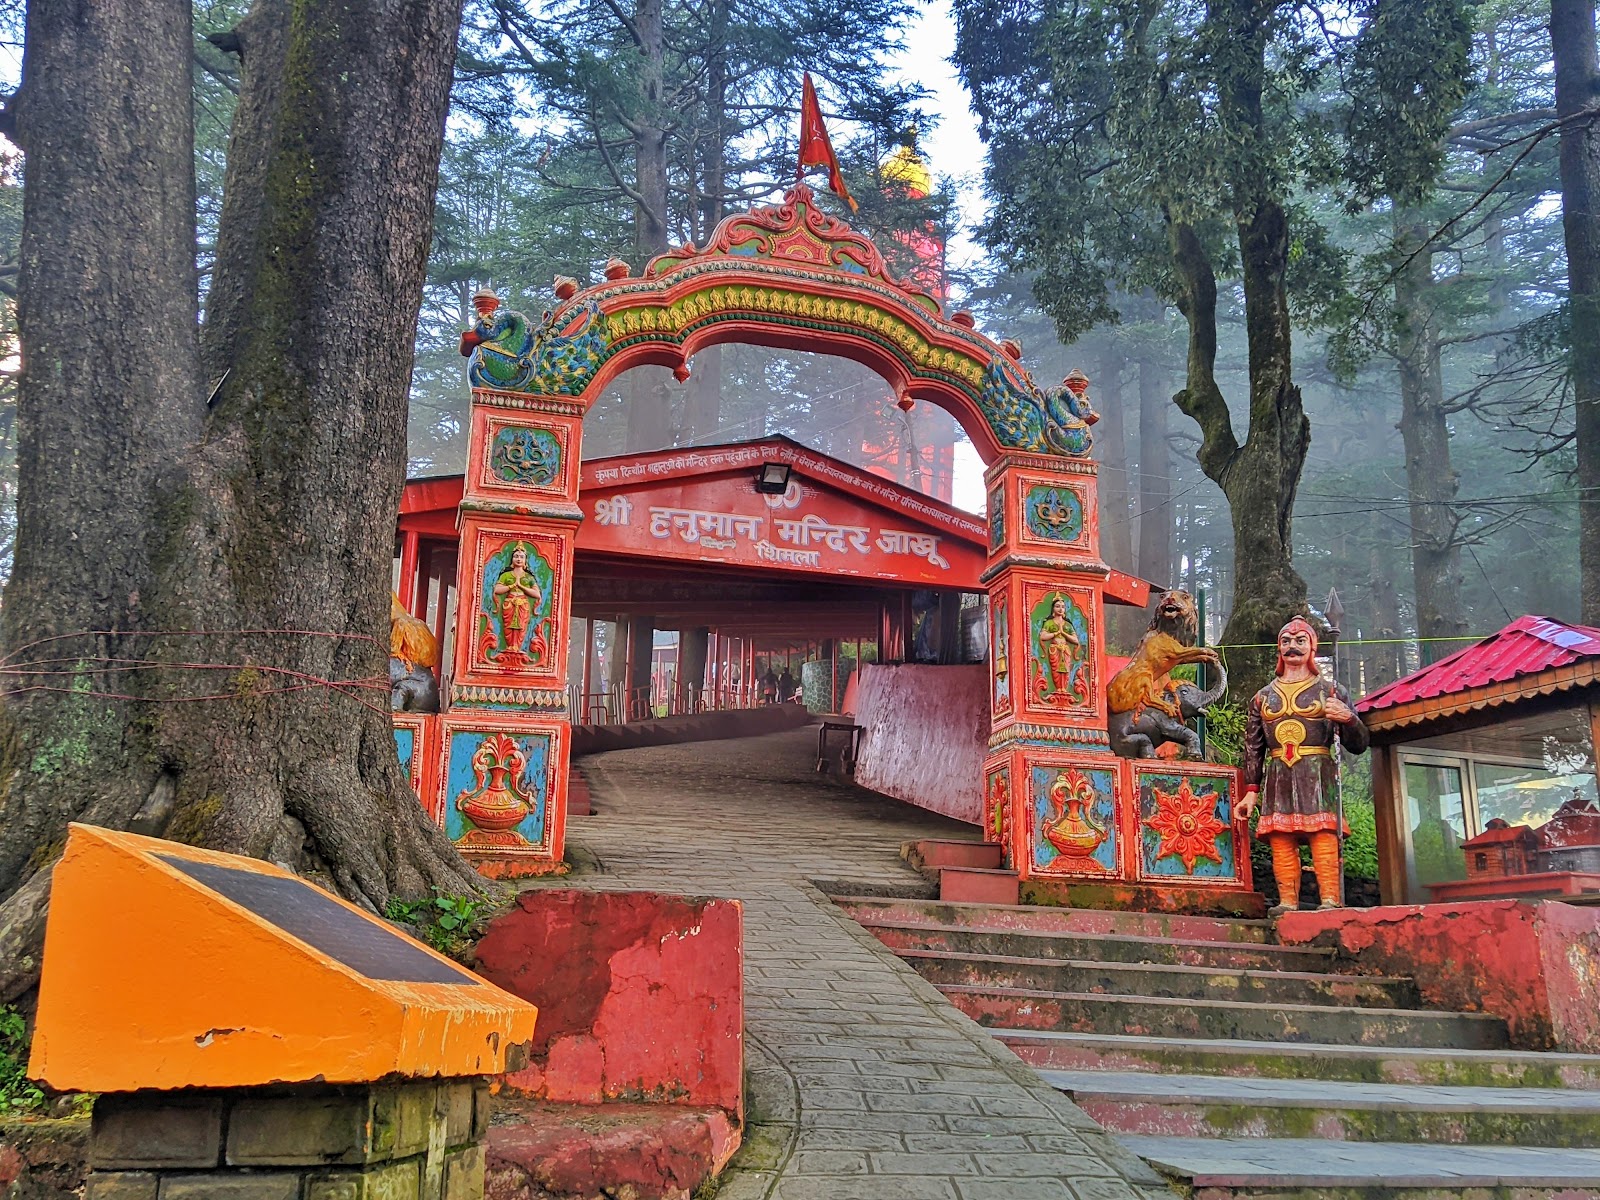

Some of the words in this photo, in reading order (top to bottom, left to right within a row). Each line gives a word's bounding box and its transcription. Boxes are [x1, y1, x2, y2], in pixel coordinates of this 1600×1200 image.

[710, 453, 724, 465] तक
[594, 494, 633, 526] श्री
[648, 505, 764, 543] हनुमान
[774, 513, 871, 554] मन्दिर
[875, 528, 951, 570] जाखू
[752, 538, 821, 567] शिमला
